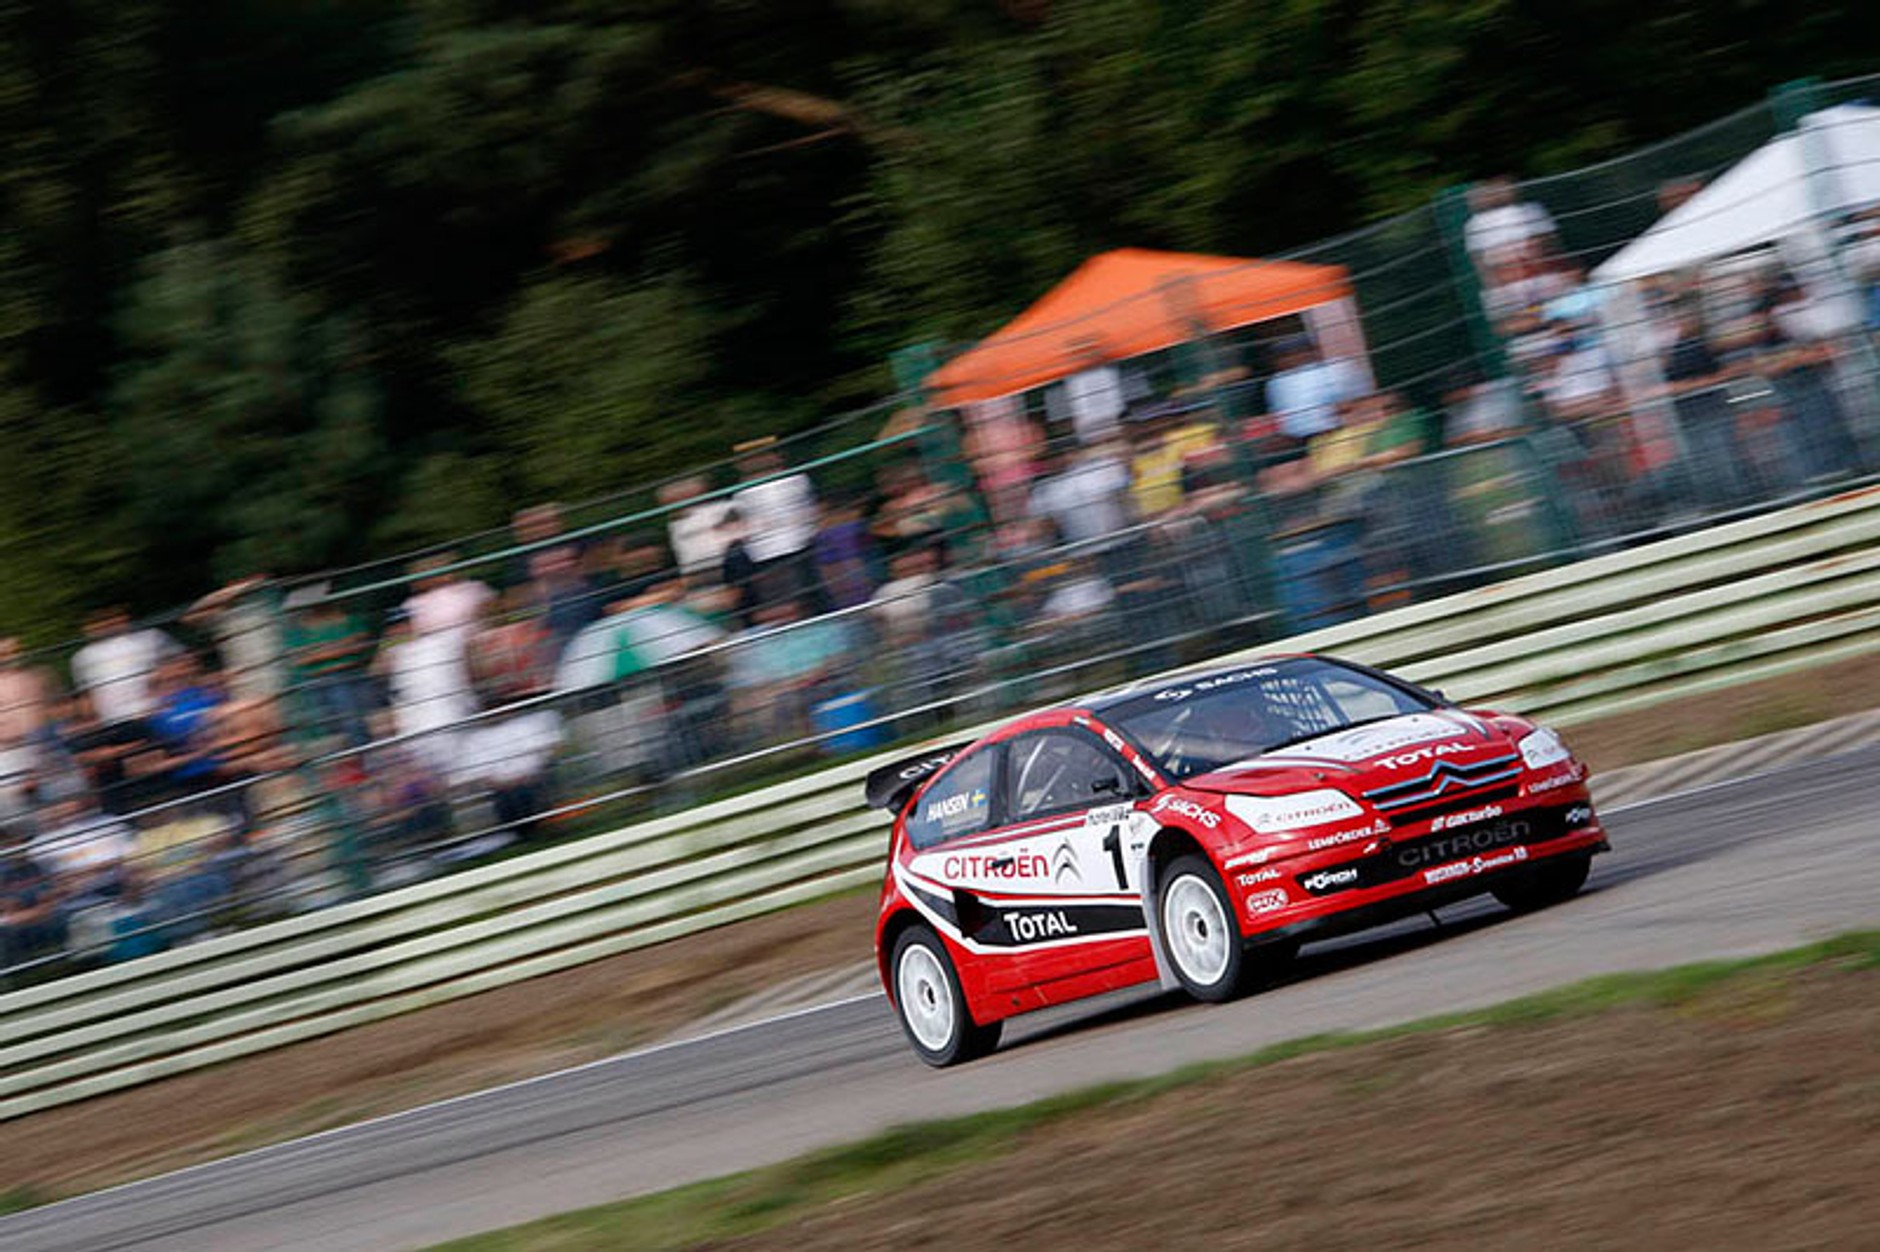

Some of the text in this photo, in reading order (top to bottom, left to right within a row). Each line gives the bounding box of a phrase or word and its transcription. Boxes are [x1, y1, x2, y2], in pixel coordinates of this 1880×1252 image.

[1195, 667, 1279, 690] SACHS
[1373, 742, 1475, 770] TOTAL
[1168, 799, 1221, 829] SACHS
[1103, 824, 1129, 890] 1
[1398, 819, 1530, 866] CITROËN
[944, 847, 1049, 879] CITROËN
[1236, 867, 1282, 887] TOTAL
[1003, 910, 1078, 942] TOTAL
